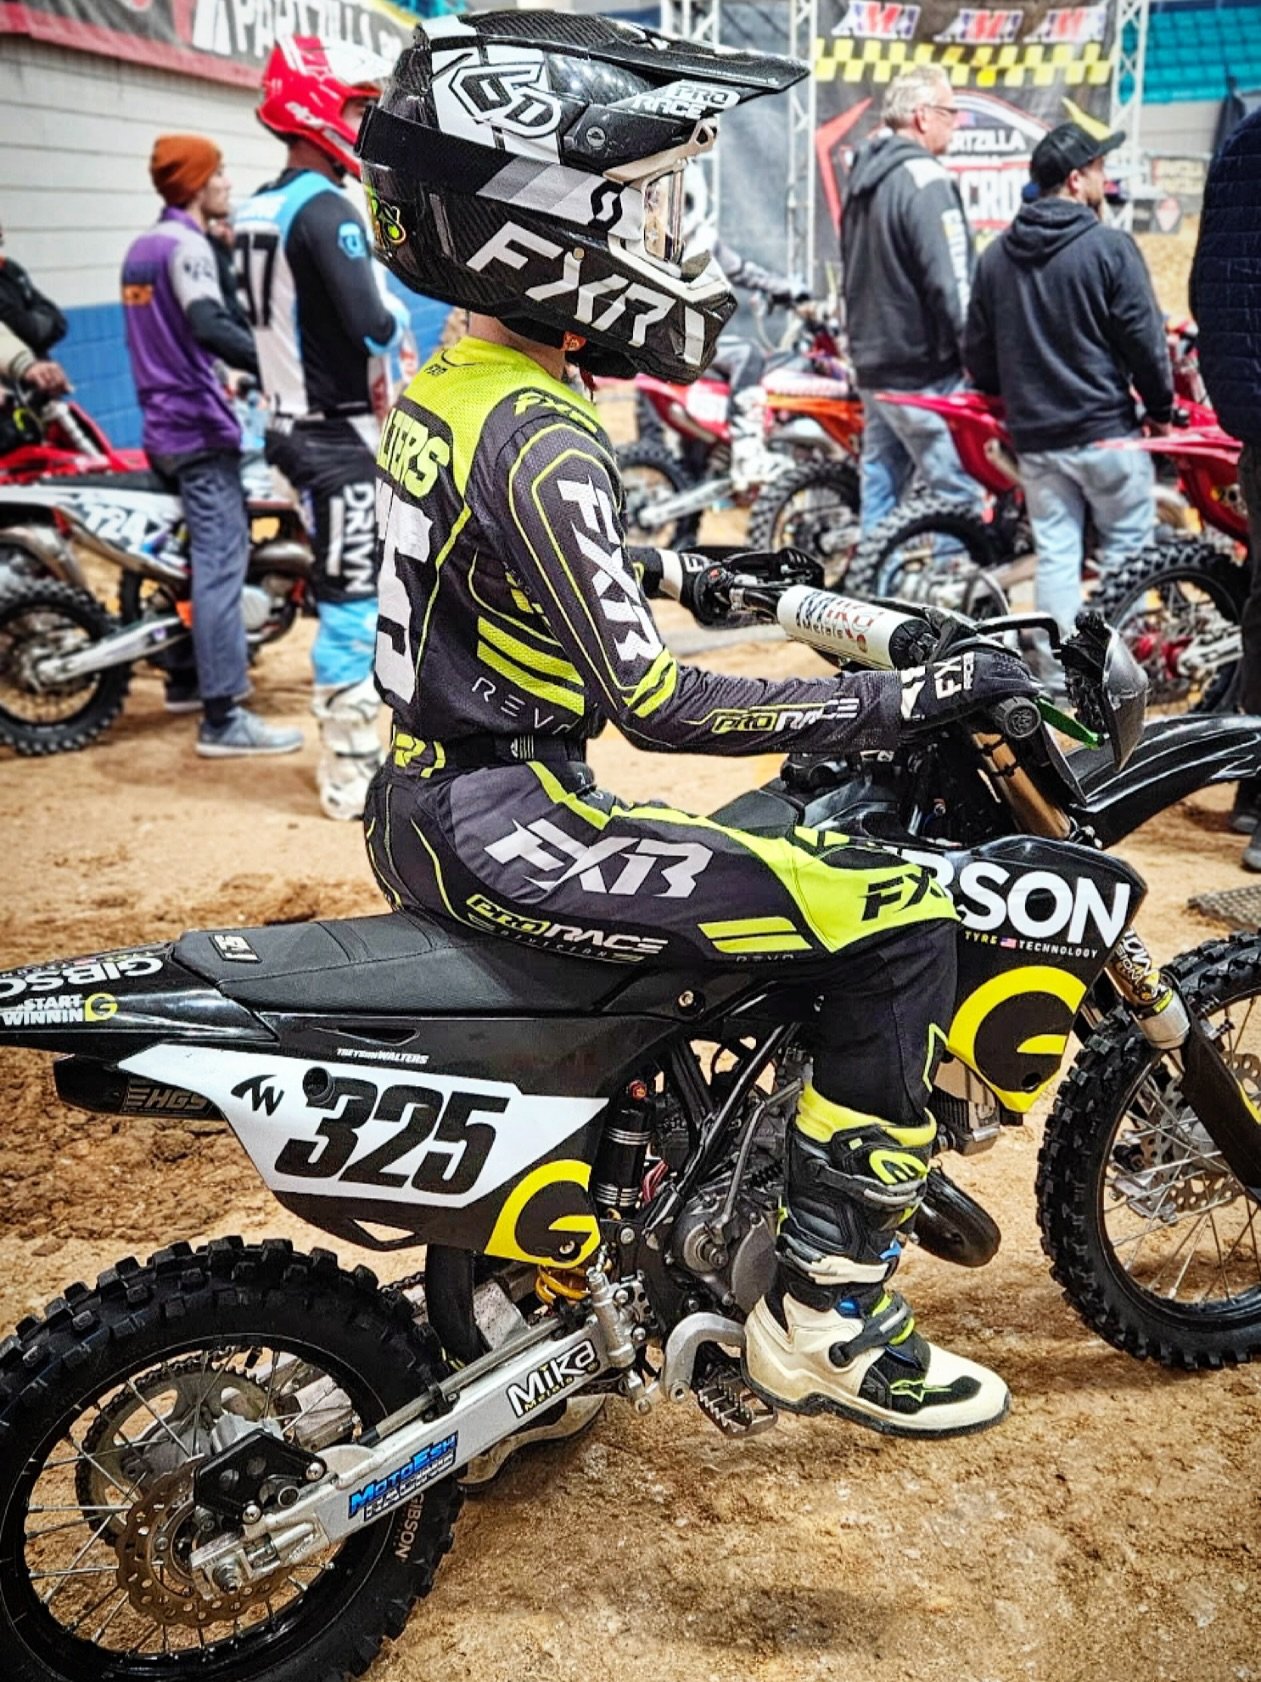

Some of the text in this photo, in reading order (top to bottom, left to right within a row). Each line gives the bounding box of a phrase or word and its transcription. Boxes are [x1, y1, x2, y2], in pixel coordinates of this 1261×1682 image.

[831, 0, 921, 39] AMA
[934, 8, 1023, 43] AMA
[632, 96, 707, 119] RACE
[668, 83, 740, 107] PRO
[466, 220, 677, 348] FXR
[711, 711, 778, 734] PRO
[484, 818, 713, 898] FXR
[466, 894, 668, 955] PRO RACE
[964, 931, 1098, 959] TYRE TECHNOLOGY
[274, 1076, 511, 1195] 325
[507, 1339, 598, 1416] Mika
